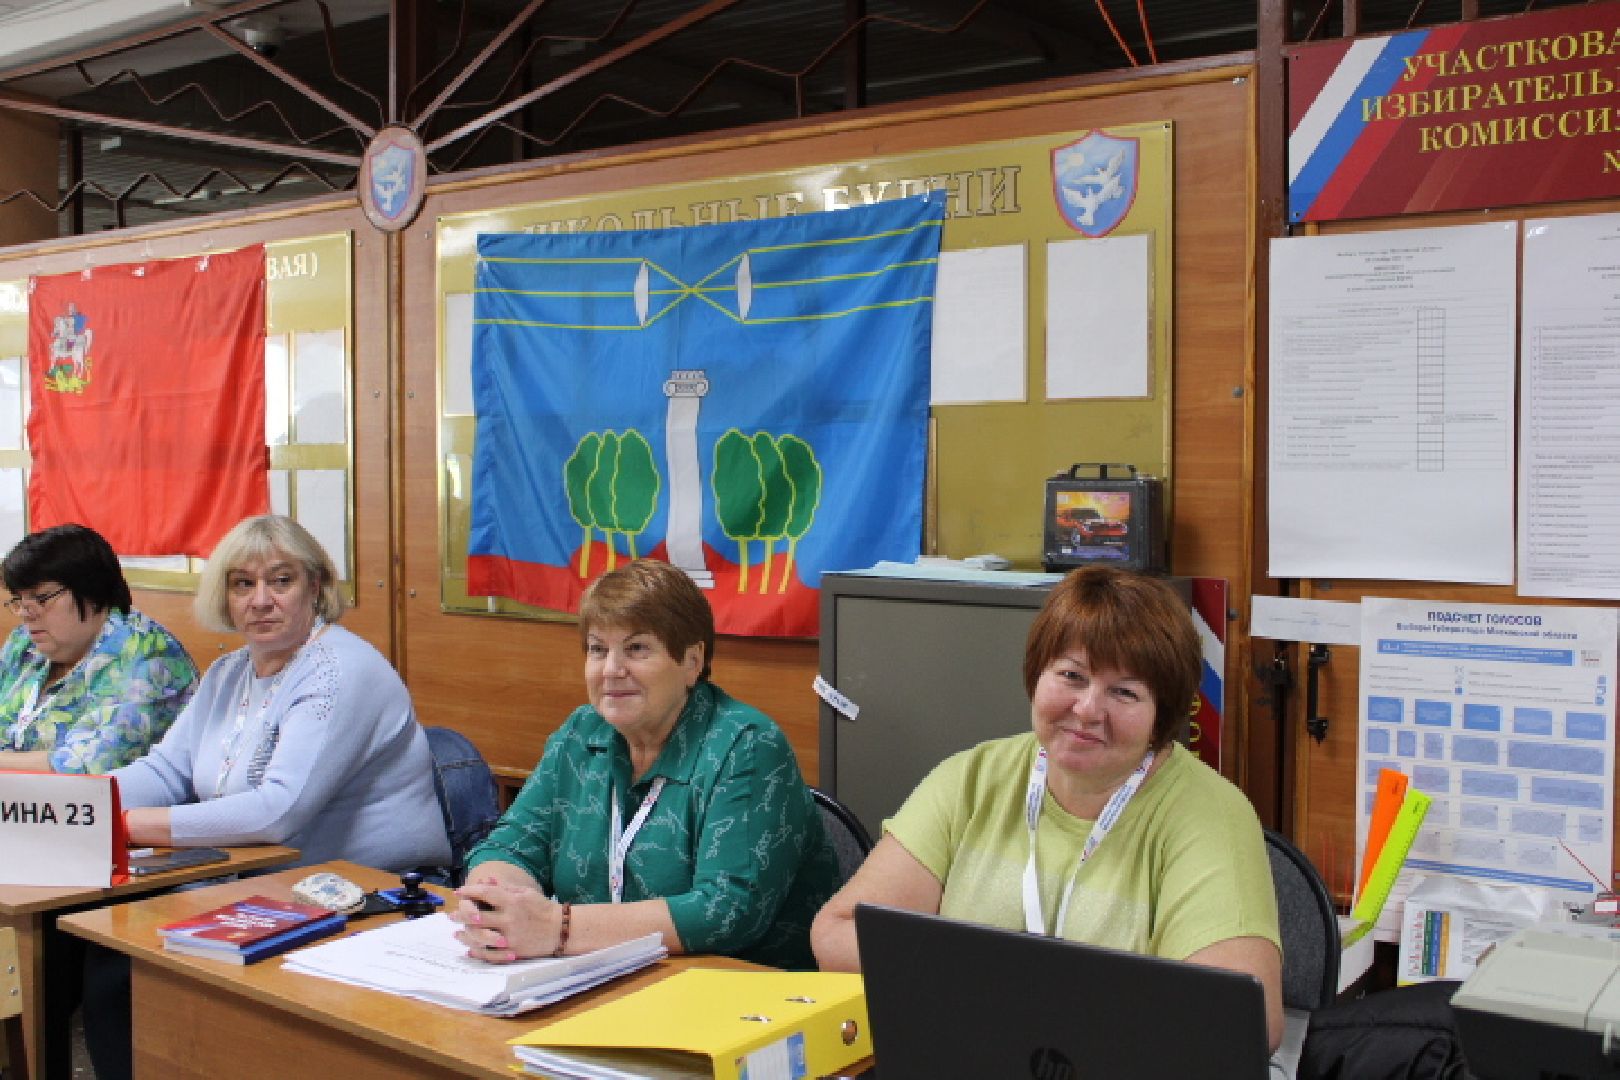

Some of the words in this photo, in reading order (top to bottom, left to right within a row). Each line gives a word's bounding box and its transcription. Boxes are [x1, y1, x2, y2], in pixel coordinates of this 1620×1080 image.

[1361, 67, 1620, 122] ИЗБИРАТЕЛЬ
[1418, 106, 1620, 153] КОМИССИ
[1486, 614, 1542, 626] ГОЛОСОВ
[1, 802, 58, 824] ИНА
[64, 802, 95, 826] 23
